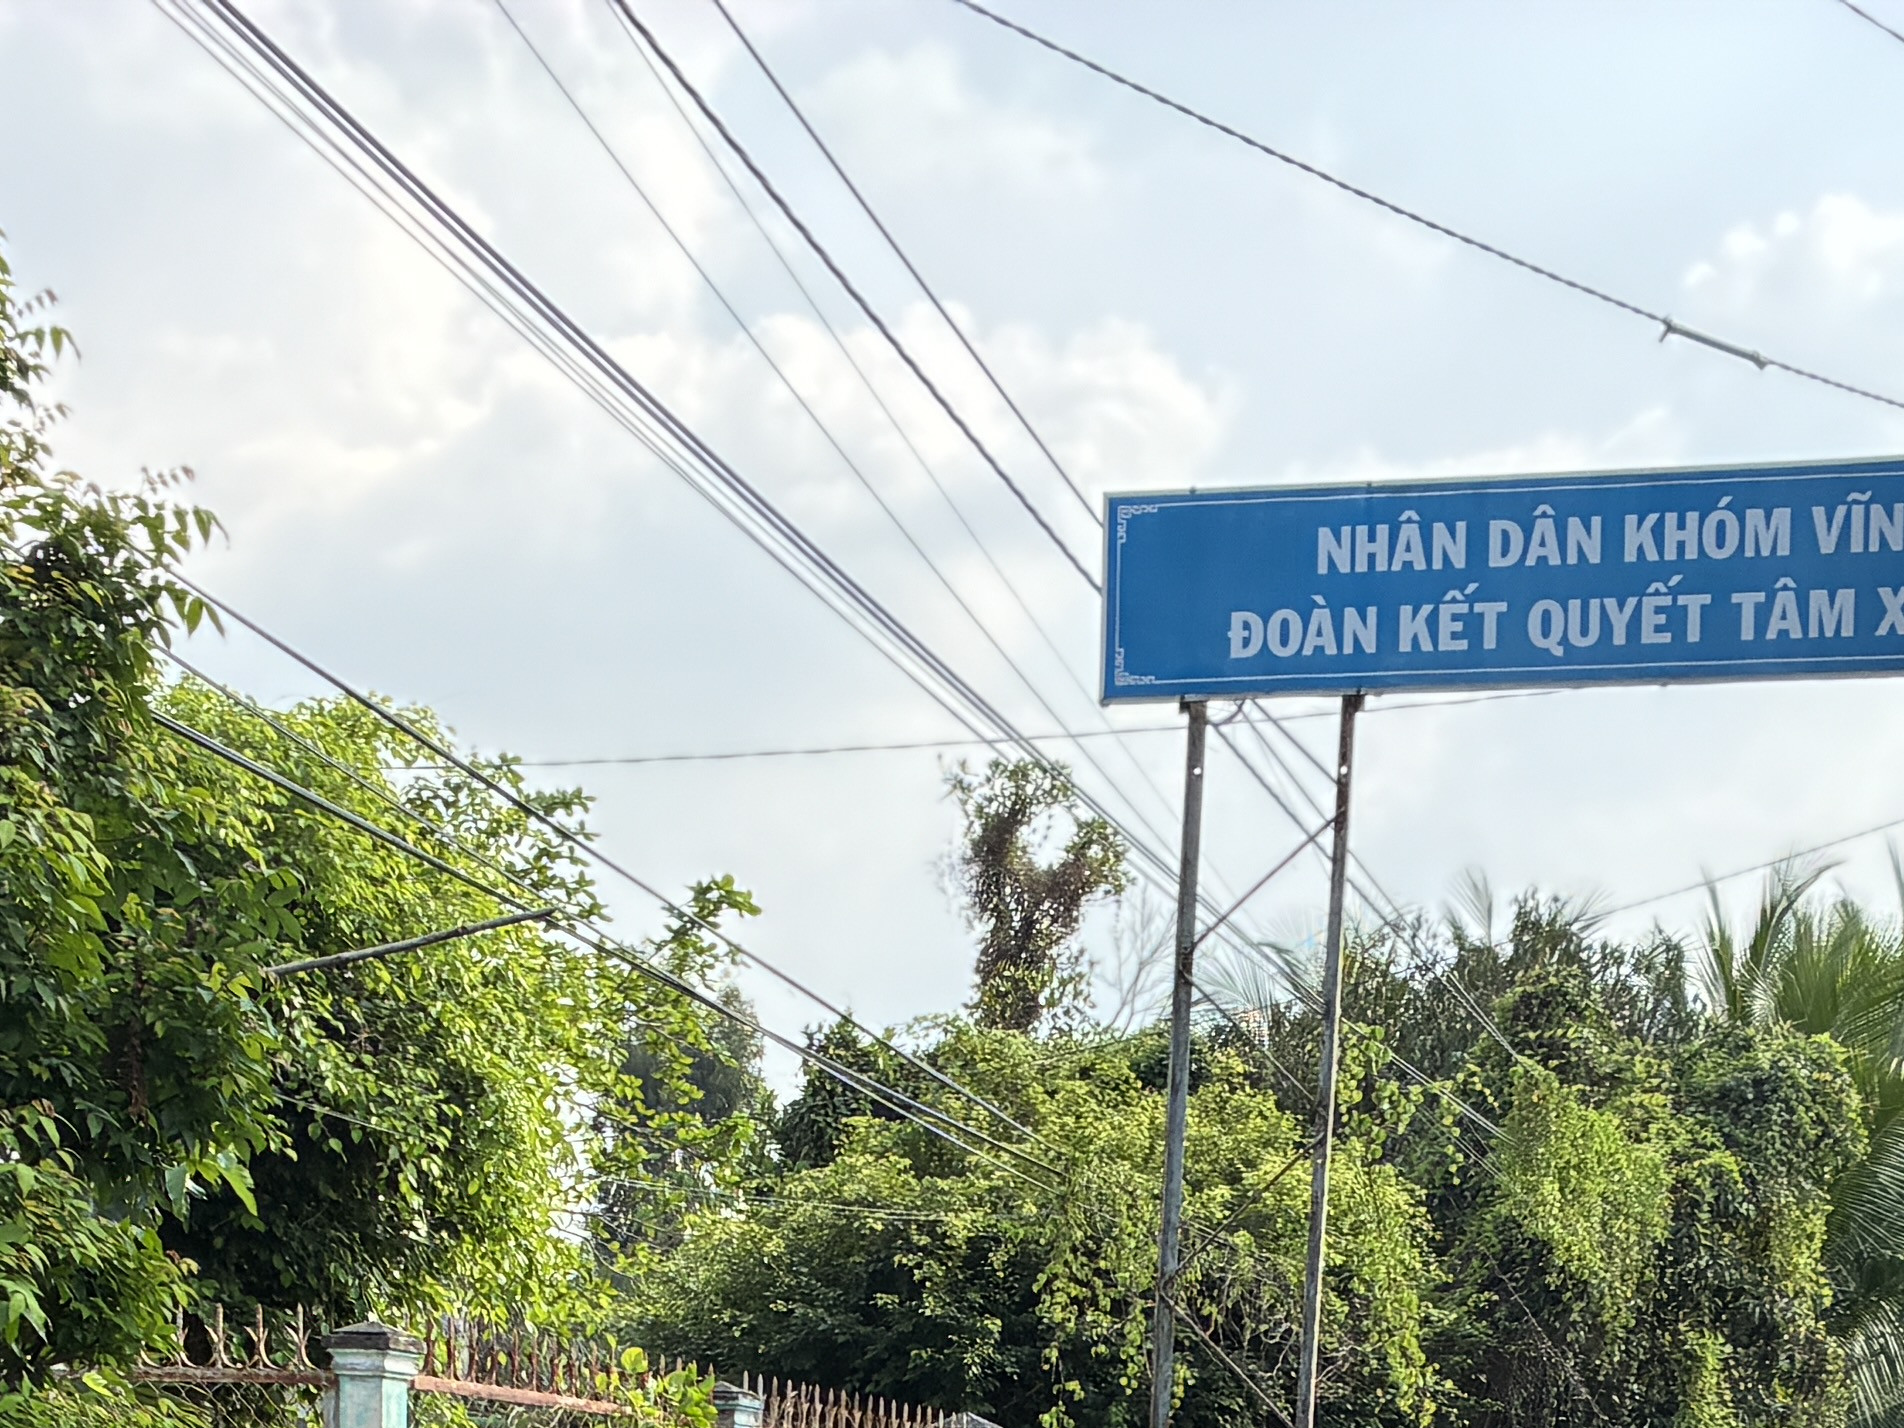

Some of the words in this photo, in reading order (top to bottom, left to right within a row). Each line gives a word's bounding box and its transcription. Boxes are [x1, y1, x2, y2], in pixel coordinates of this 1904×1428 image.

[1316, 509, 1467, 575] NHÂN
[1488, 503, 1602, 568] DÂN
[1623, 495, 1792, 563] KHÓM
[1227, 594, 1379, 659] ĐOÀN
[1397, 582, 1508, 653] KẾT
[1526, 573, 1711, 657] QUYẾT
[1731, 576, 1855, 641] TÂM
